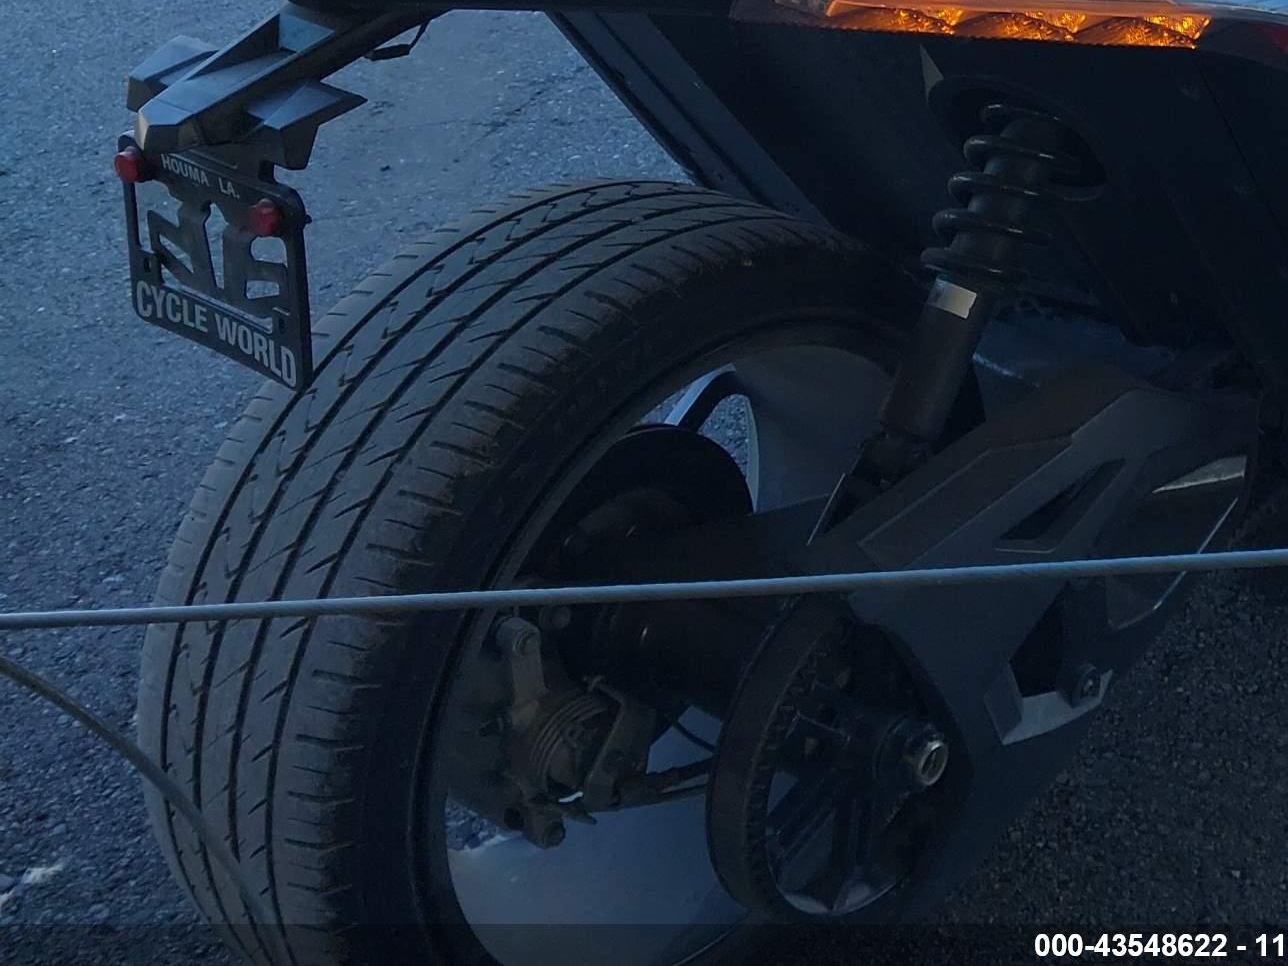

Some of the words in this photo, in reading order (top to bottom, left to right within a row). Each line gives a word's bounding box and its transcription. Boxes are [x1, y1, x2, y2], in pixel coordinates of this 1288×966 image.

[161, 153, 210, 187] HOUMA
[136, 280, 209, 333] CYCLE
[214, 312, 297, 387] WORLD
